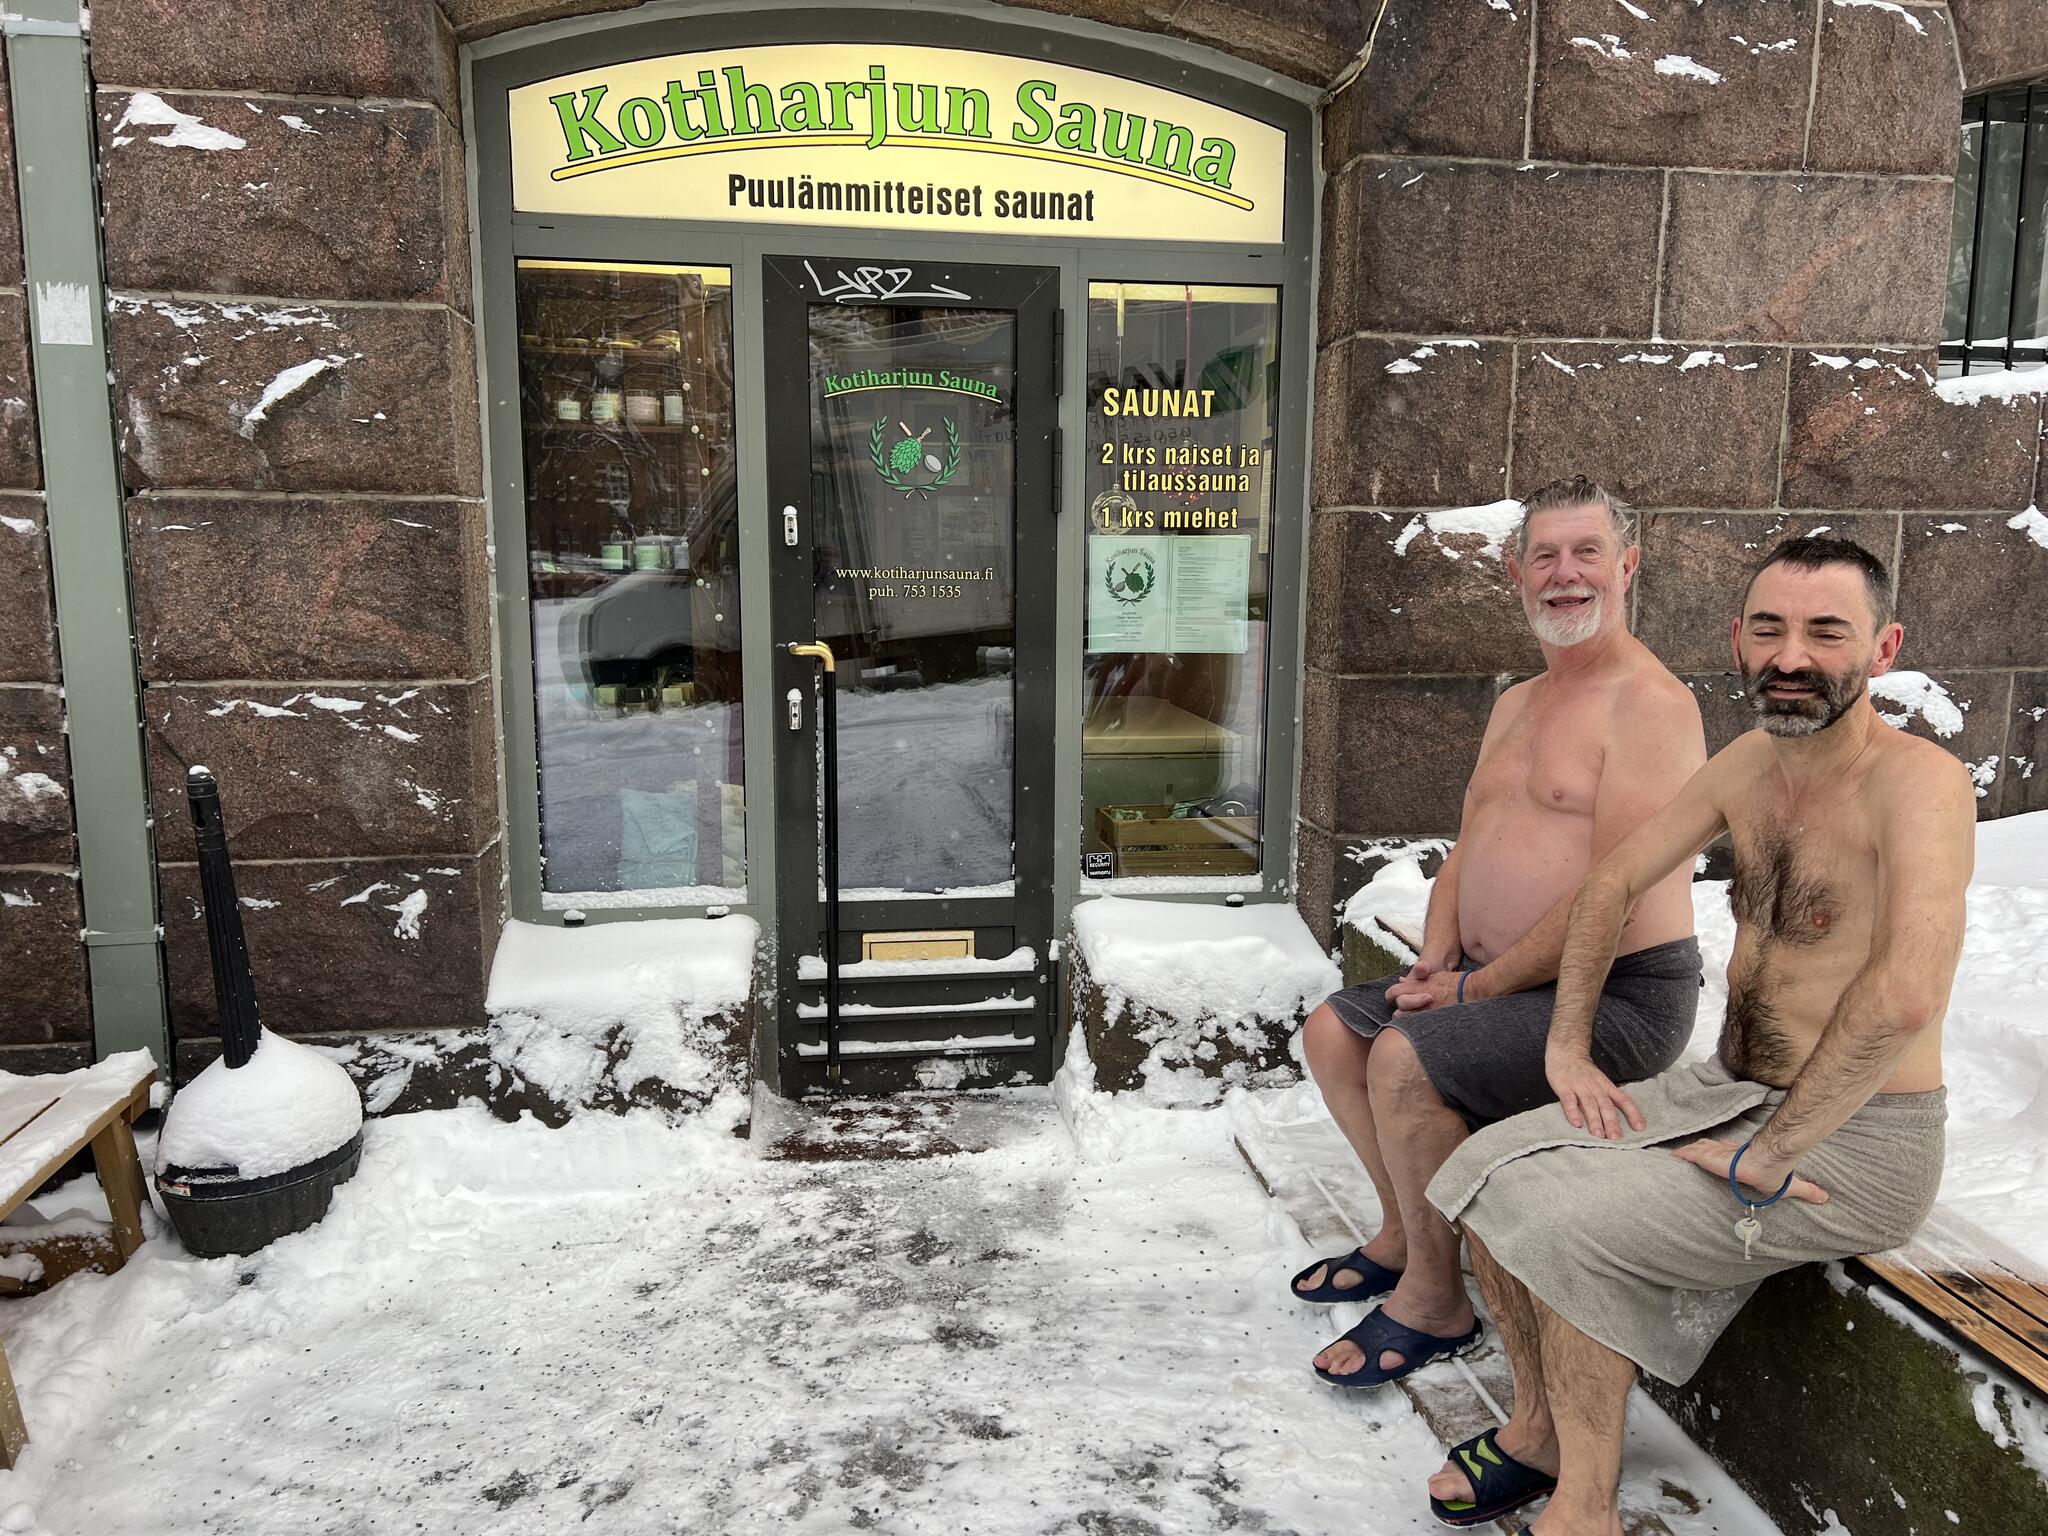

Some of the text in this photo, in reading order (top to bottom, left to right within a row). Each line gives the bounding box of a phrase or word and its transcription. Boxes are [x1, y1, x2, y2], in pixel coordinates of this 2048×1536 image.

[549, 65, 1236, 188] Kotiharjun Sauna
[728, 173, 1095, 222] Puulämmitteiset saunat
[824, 368, 998, 398] Kotiharjun Sauna
[1103, 387, 1216, 418] SAUNAT
[1102, 442, 1261, 468] 2 krs naiset ja
[1123, 469, 1251, 492] tilaussauna
[1102, 507, 1239, 529] 1 krs miehet
[835, 566, 994, 582] www.kotiharjunsauna.fi
[868, 584, 962, 600] puh. 753 1535
